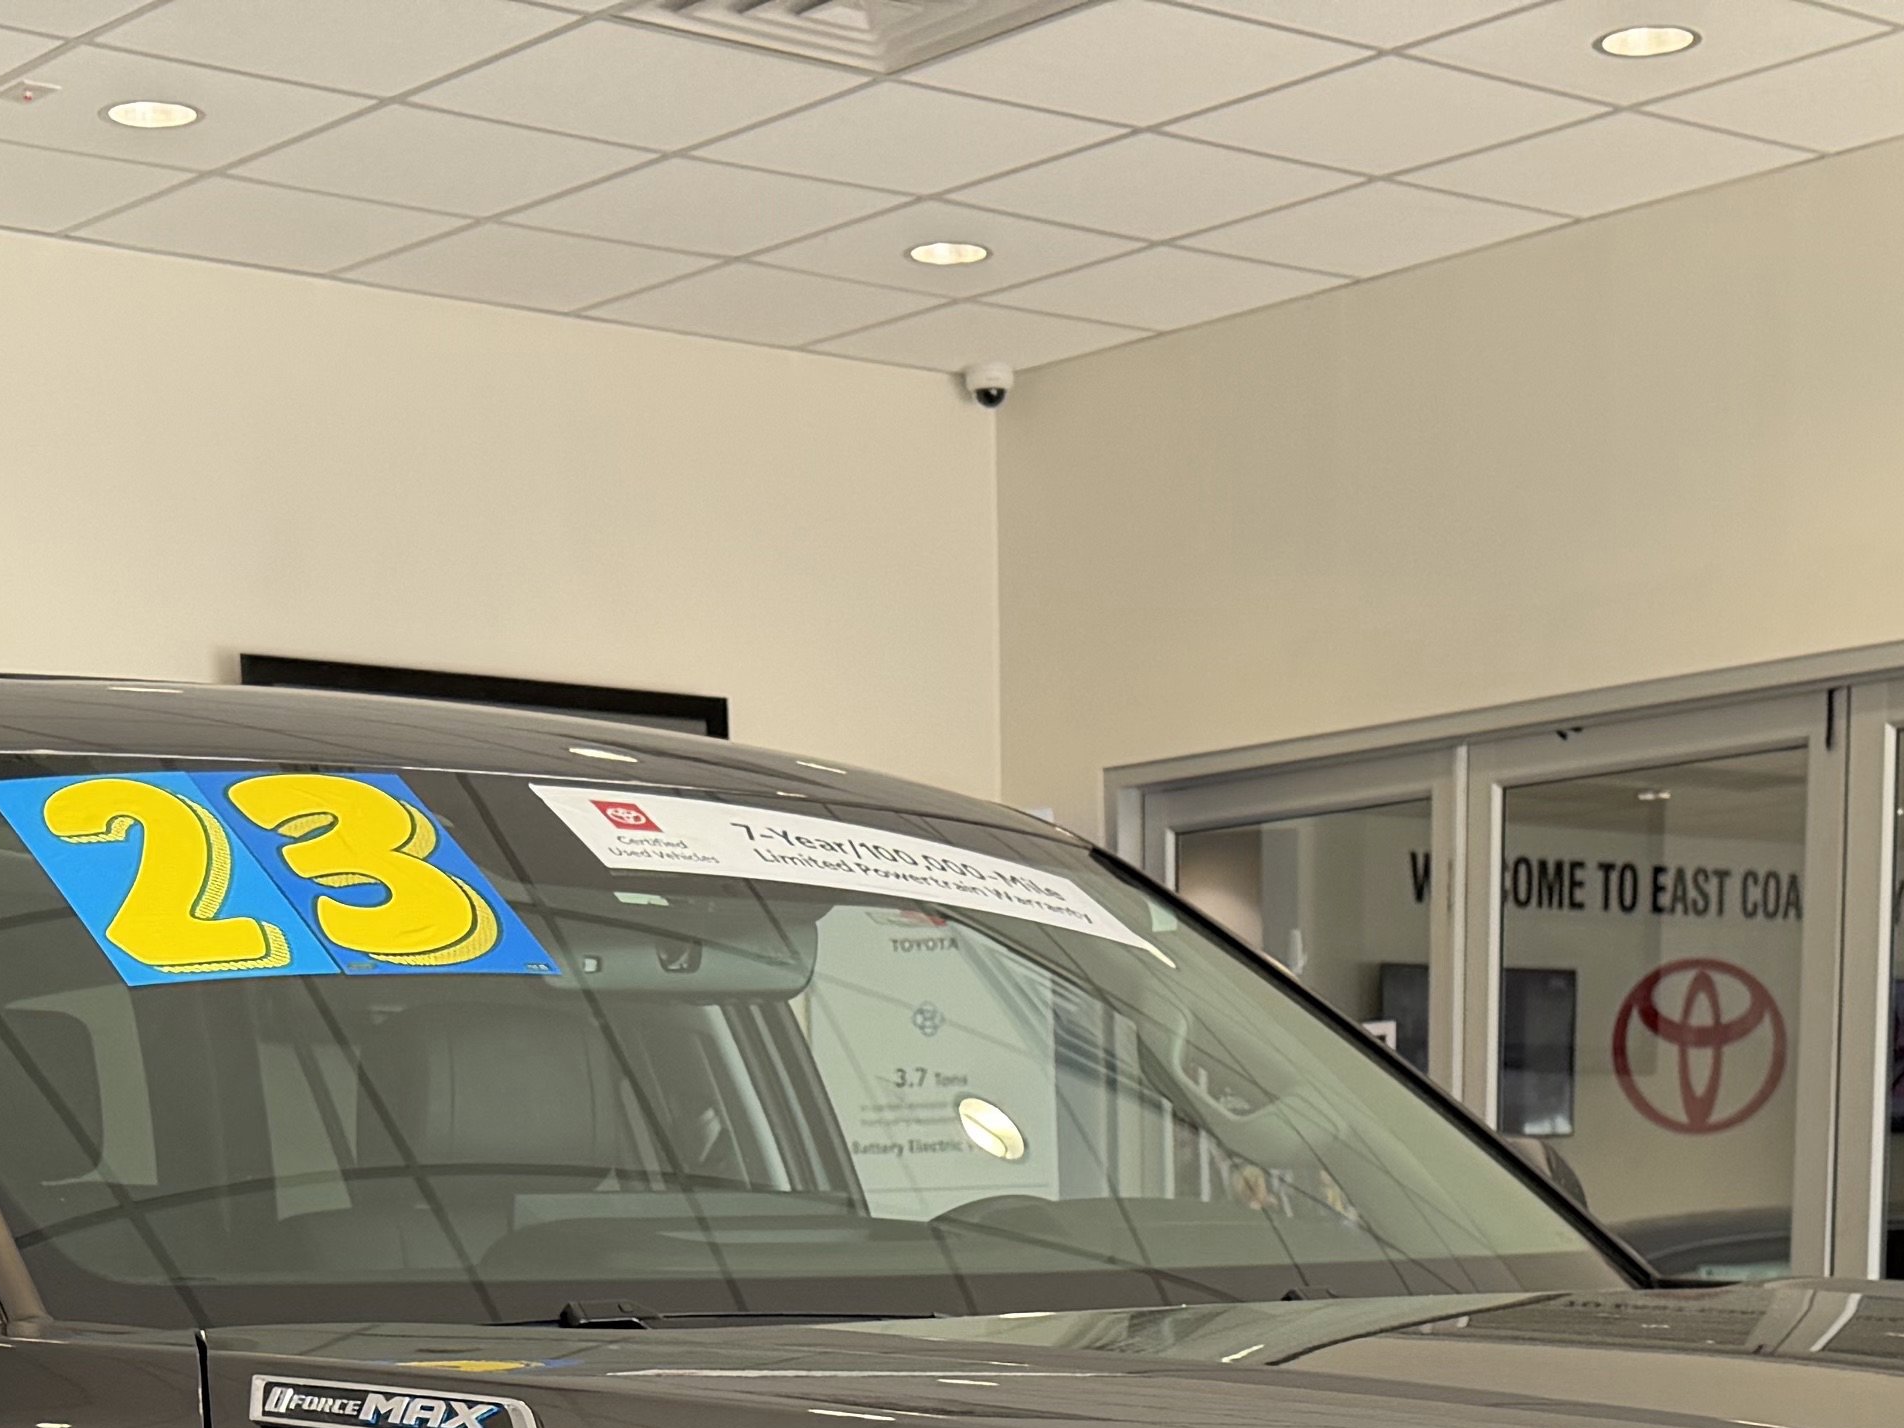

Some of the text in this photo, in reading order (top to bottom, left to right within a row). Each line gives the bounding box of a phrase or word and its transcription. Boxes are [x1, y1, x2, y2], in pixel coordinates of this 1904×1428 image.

[616, 835, 688, 849] Certified
[608, 846, 720, 864] Used Vehicles
[43, 773, 500, 973] 23
[753, 848, 1094, 925] Limited Powertrain Warranty
[1409, 851, 1585, 911] WOME
[1597, 862, 1638, 913] TO
[1652, 866, 1731, 918] EAST
[1741, 870, 1803, 921] COA
[892, 937, 960, 952] TOYOTA
[895, 1067, 928, 1089] 3.7
